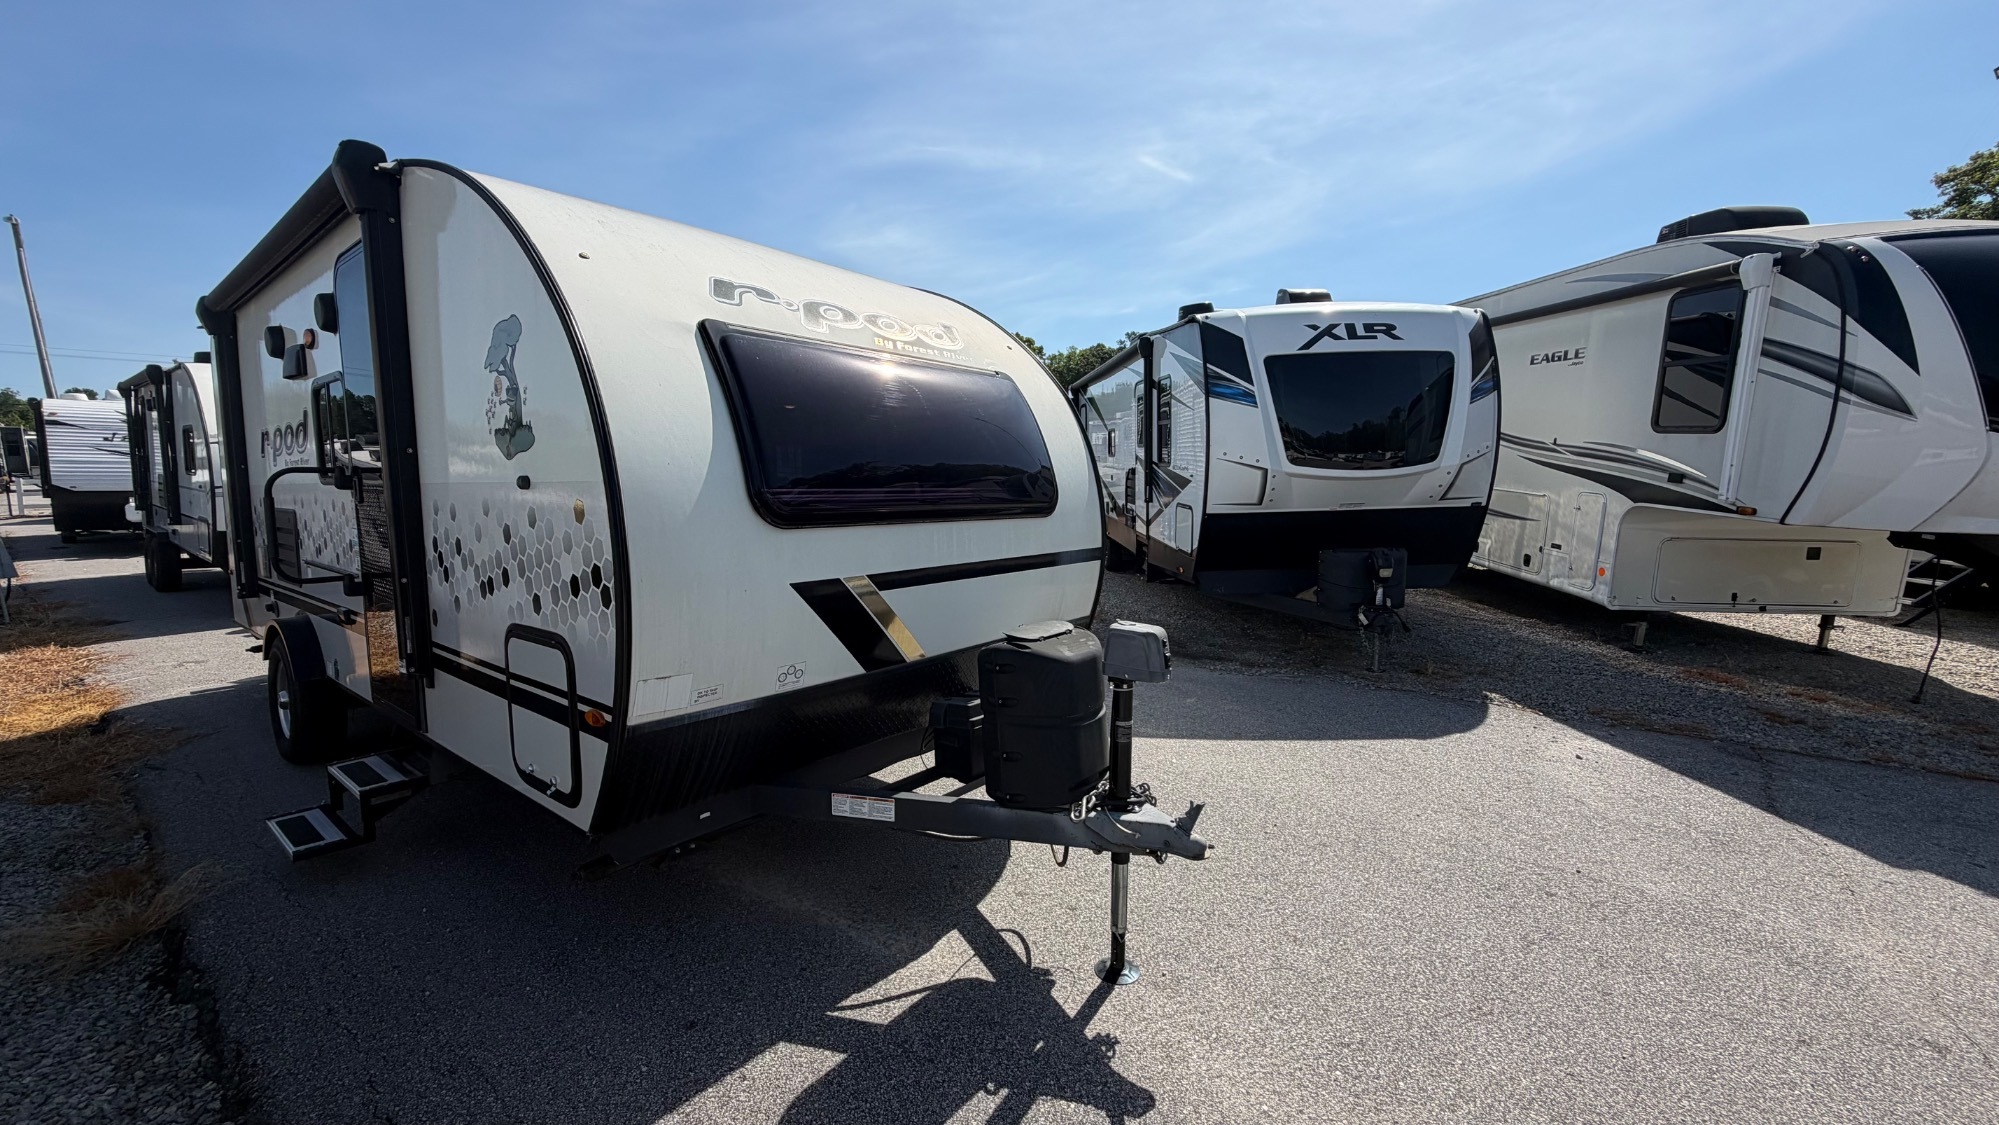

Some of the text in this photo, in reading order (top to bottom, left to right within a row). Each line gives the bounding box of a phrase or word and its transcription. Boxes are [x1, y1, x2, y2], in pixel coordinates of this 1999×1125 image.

[874, 337, 894, 350] By
[896, 341, 941, 356] Forest
[1296, 323, 1405, 351] XLR
[1529, 347, 1588, 366] EAGLE
